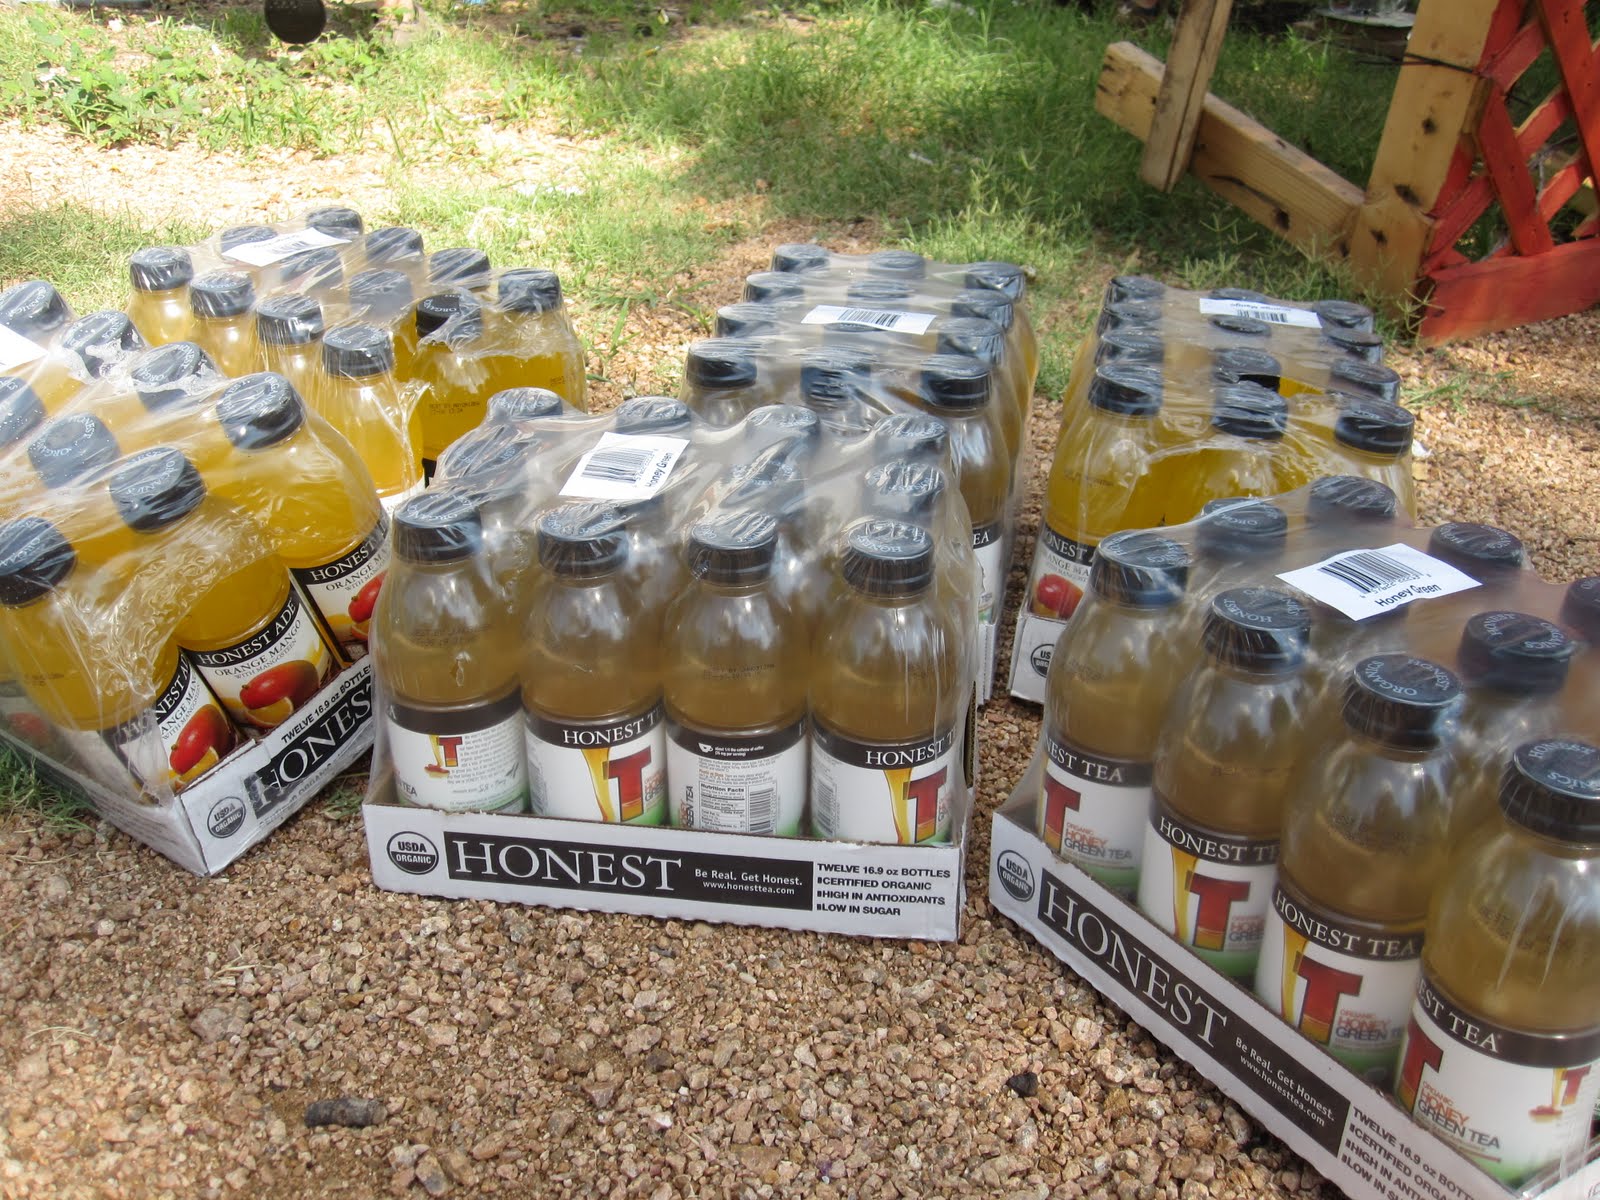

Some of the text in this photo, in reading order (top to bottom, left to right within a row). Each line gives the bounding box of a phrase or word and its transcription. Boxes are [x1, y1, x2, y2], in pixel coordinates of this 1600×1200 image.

[645, 466, 666, 488] Honey
[310, 541, 376, 581] HONEST
[325, 563, 374, 592] ORANGE
[1374, 583, 1442, 608] Honey Green
[1222, 598, 1273, 623] HONEST
[198, 598, 296, 666] HONEST ADE
[215, 619, 301, 677] ORANGE MANGO
[234, 669, 256, 680] WITH
[1364, 659, 1418, 696] ORGANICS
[1406, 658, 1451, 692] HONEST
[281, 712, 314, 744] TWELVE
[314, 702, 330, 717] 16.9
[330, 693, 341, 704] oz
[562, 717, 645, 746] HONEST
[865, 737, 945, 766] HONEST
[1527, 741, 1597, 760] HONEST
[1081, 759, 1123, 783] TEA
[700, 783, 727, 792] Nutrition
[214, 802, 236, 822] USDA
[215, 812, 242, 833] ORGANIC
[397, 840, 427, 853] USDA
[1064, 837, 1133, 860] GREEN TEA
[1066, 828, 1109, 849] HONEY
[1160, 816, 1248, 862] HONEST
[395, 853, 432, 865] ORGANIC
[451, 840, 682, 891] HONEST
[817, 862, 951, 879] TWELVE 16.9 oz BOTTLES
[1006, 857, 1028, 881] USDA
[694, 868, 803, 886] Be Real. Get Honest.
[702, 880, 795, 895] www.honesttea.com
[822, 876, 932, 891] CERTIFIED ORGANIC
[1002, 870, 1030, 895] ORGANIC
[822, 890, 946, 906] HIGH IN ANTIOXIDANTS
[822, 903, 901, 916] LOW IN SUGAR
[1276, 889, 1416, 957] HONEST TEA
[1043, 880, 1228, 1048] HONEST
[1335, 1026, 1388, 1041] GREEN
[1337, 1018, 1391, 1031] HONEY
[1448, 1011, 1498, 1054] TEA
[1235, 1036, 1335, 1122] Be Real. Get Honest.
[1240, 1055, 1325, 1127] www.honesttea.com
[1420, 1087, 1470, 1127] HONEY
[1417, 1099, 1500, 1149] GREEN TEA
[1352, 1106, 1397, 1147] TWELVE
[1399, 1143, 1421, 1165] 16.9
[1422, 1163, 1437, 1178] oz
[1354, 1125, 1412, 1177] CERTIFIED
[1350, 1140, 1378, 1172] HIGH
[1380, 1165, 1393, 1181] IN
[1346, 1154, 1373, 1183] LOW
[1373, 1176, 1386, 1194] IN
